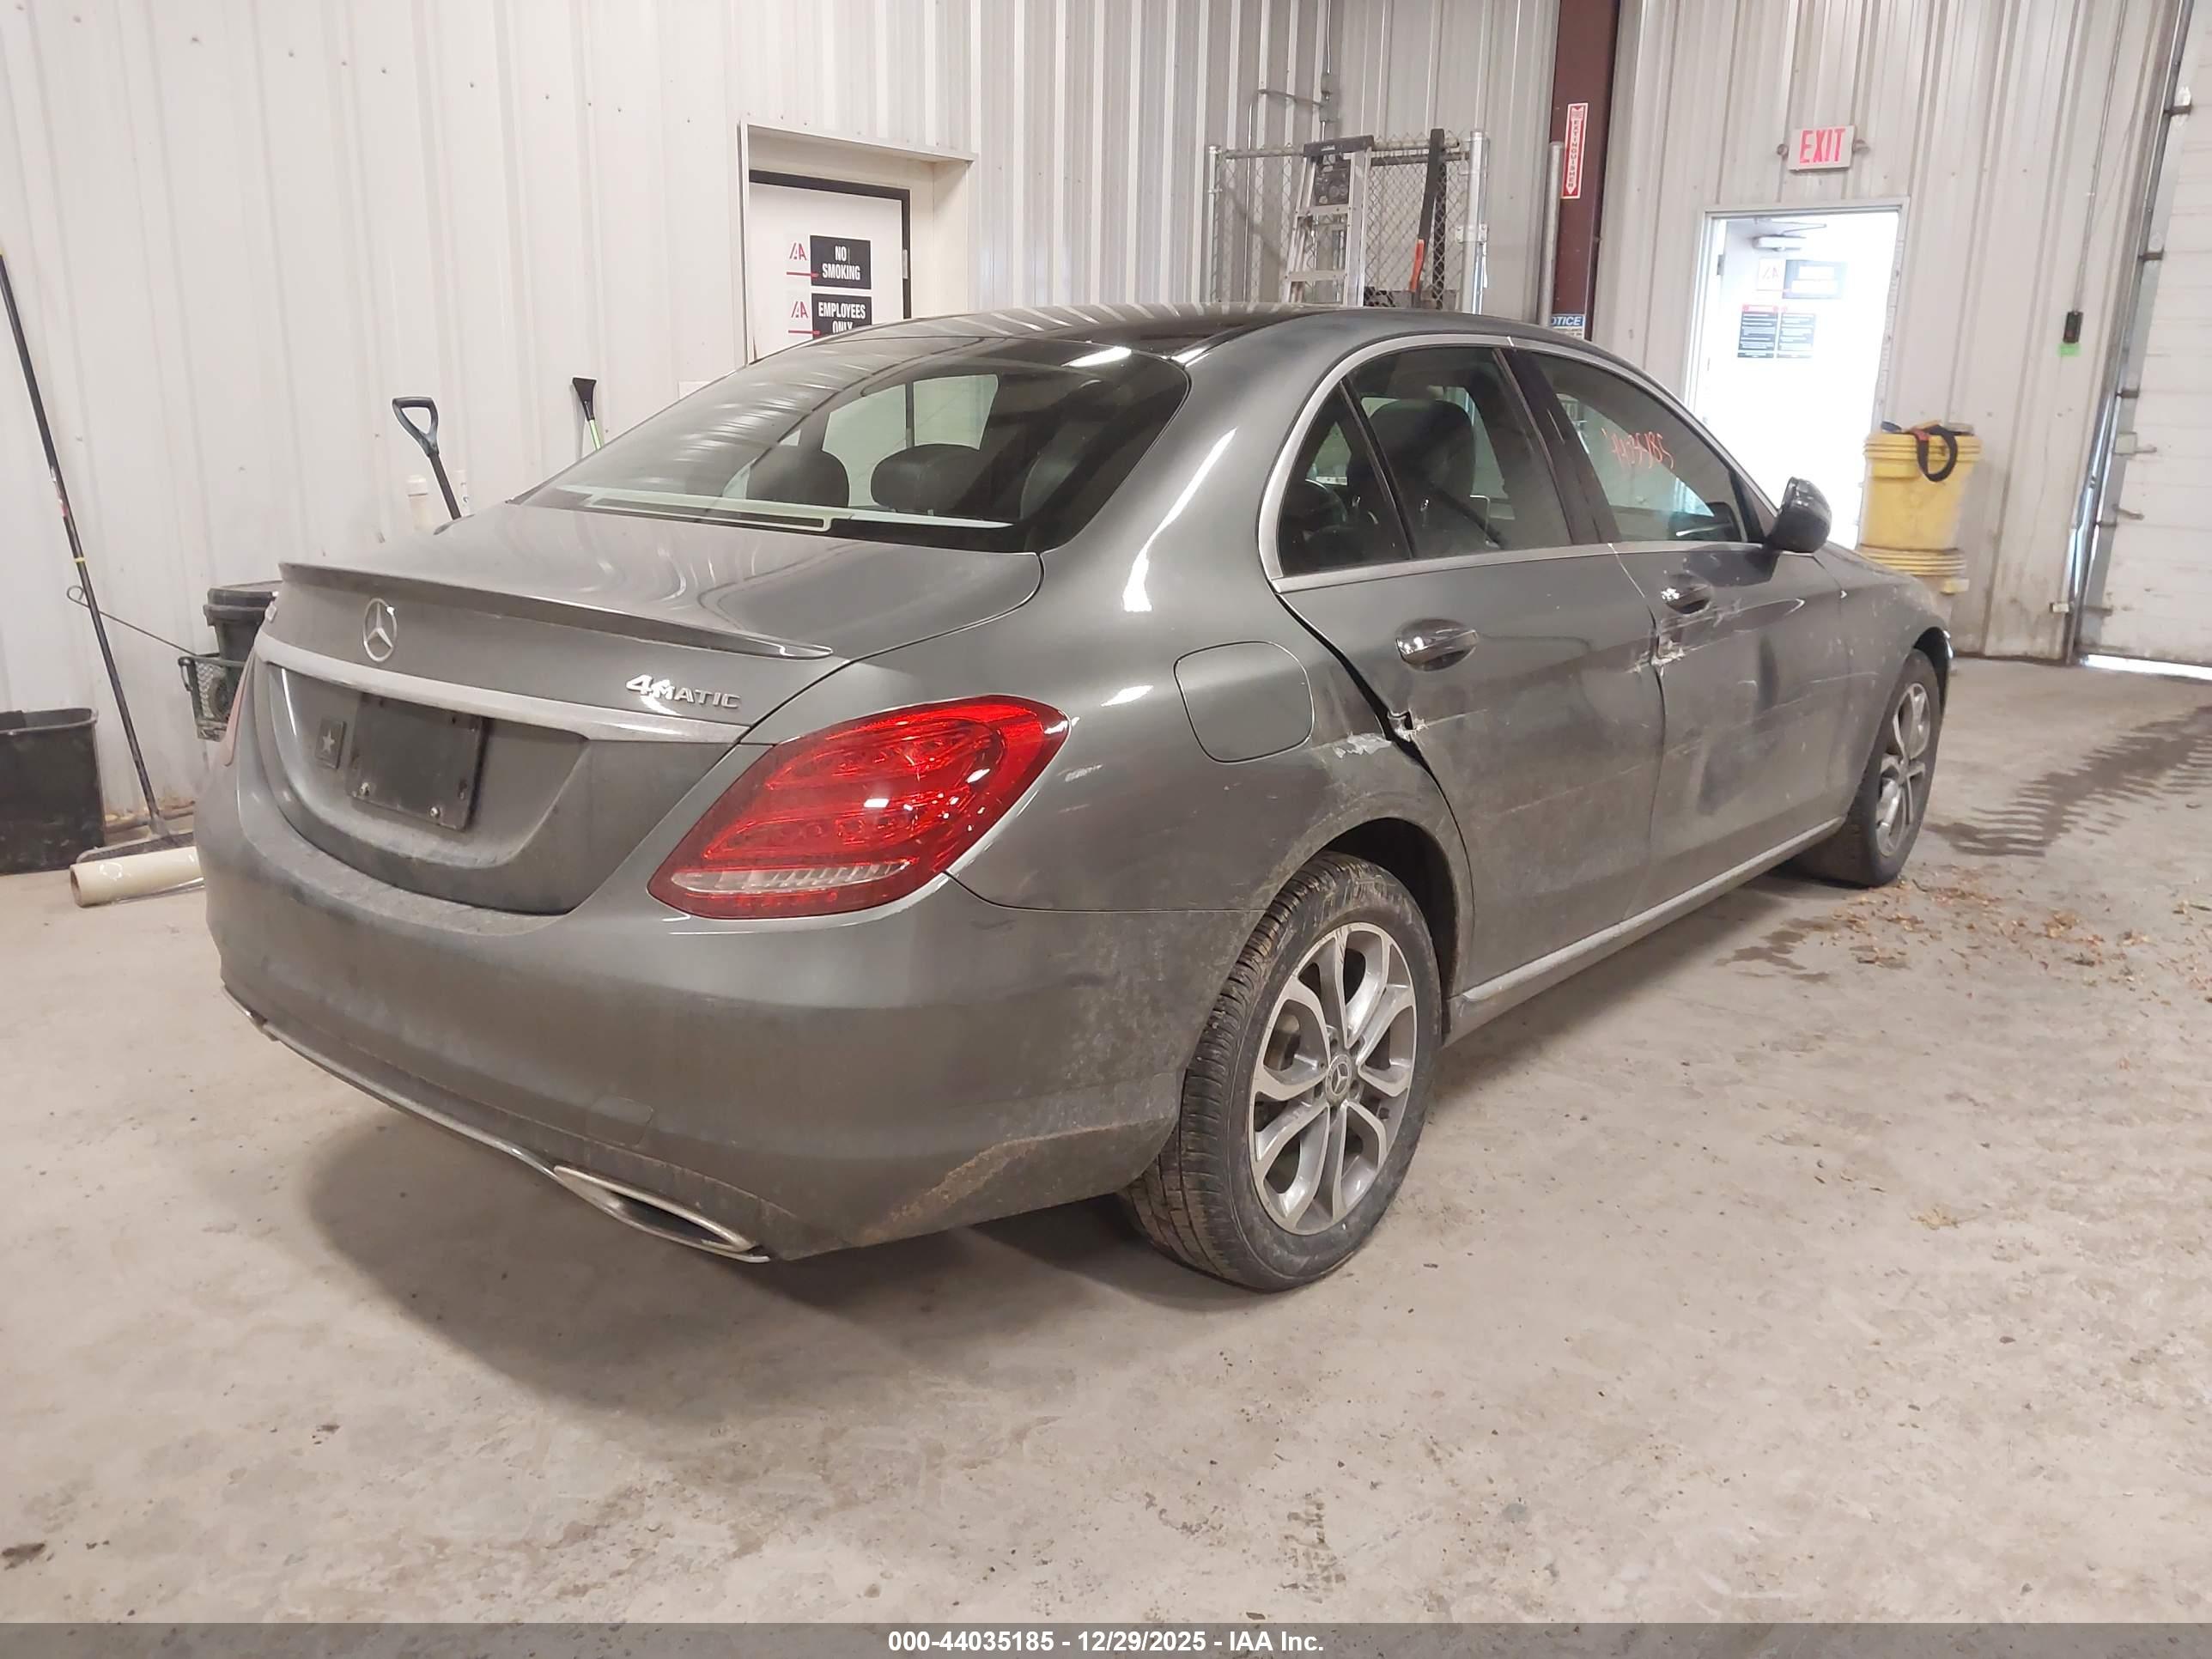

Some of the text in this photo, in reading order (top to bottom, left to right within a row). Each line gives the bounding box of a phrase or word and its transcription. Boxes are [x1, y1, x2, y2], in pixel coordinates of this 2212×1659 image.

[1799, 127, 1846, 164] EXIT
[835, 246, 847, 261] NO
[822, 263, 860, 280] SMOKING
[818, 301, 866, 319] EMPLOYEES
[832, 320, 854, 333] ONLY
[1552, 316, 1583, 326] OTICE
[625, 674, 741, 708] 4MATIC
